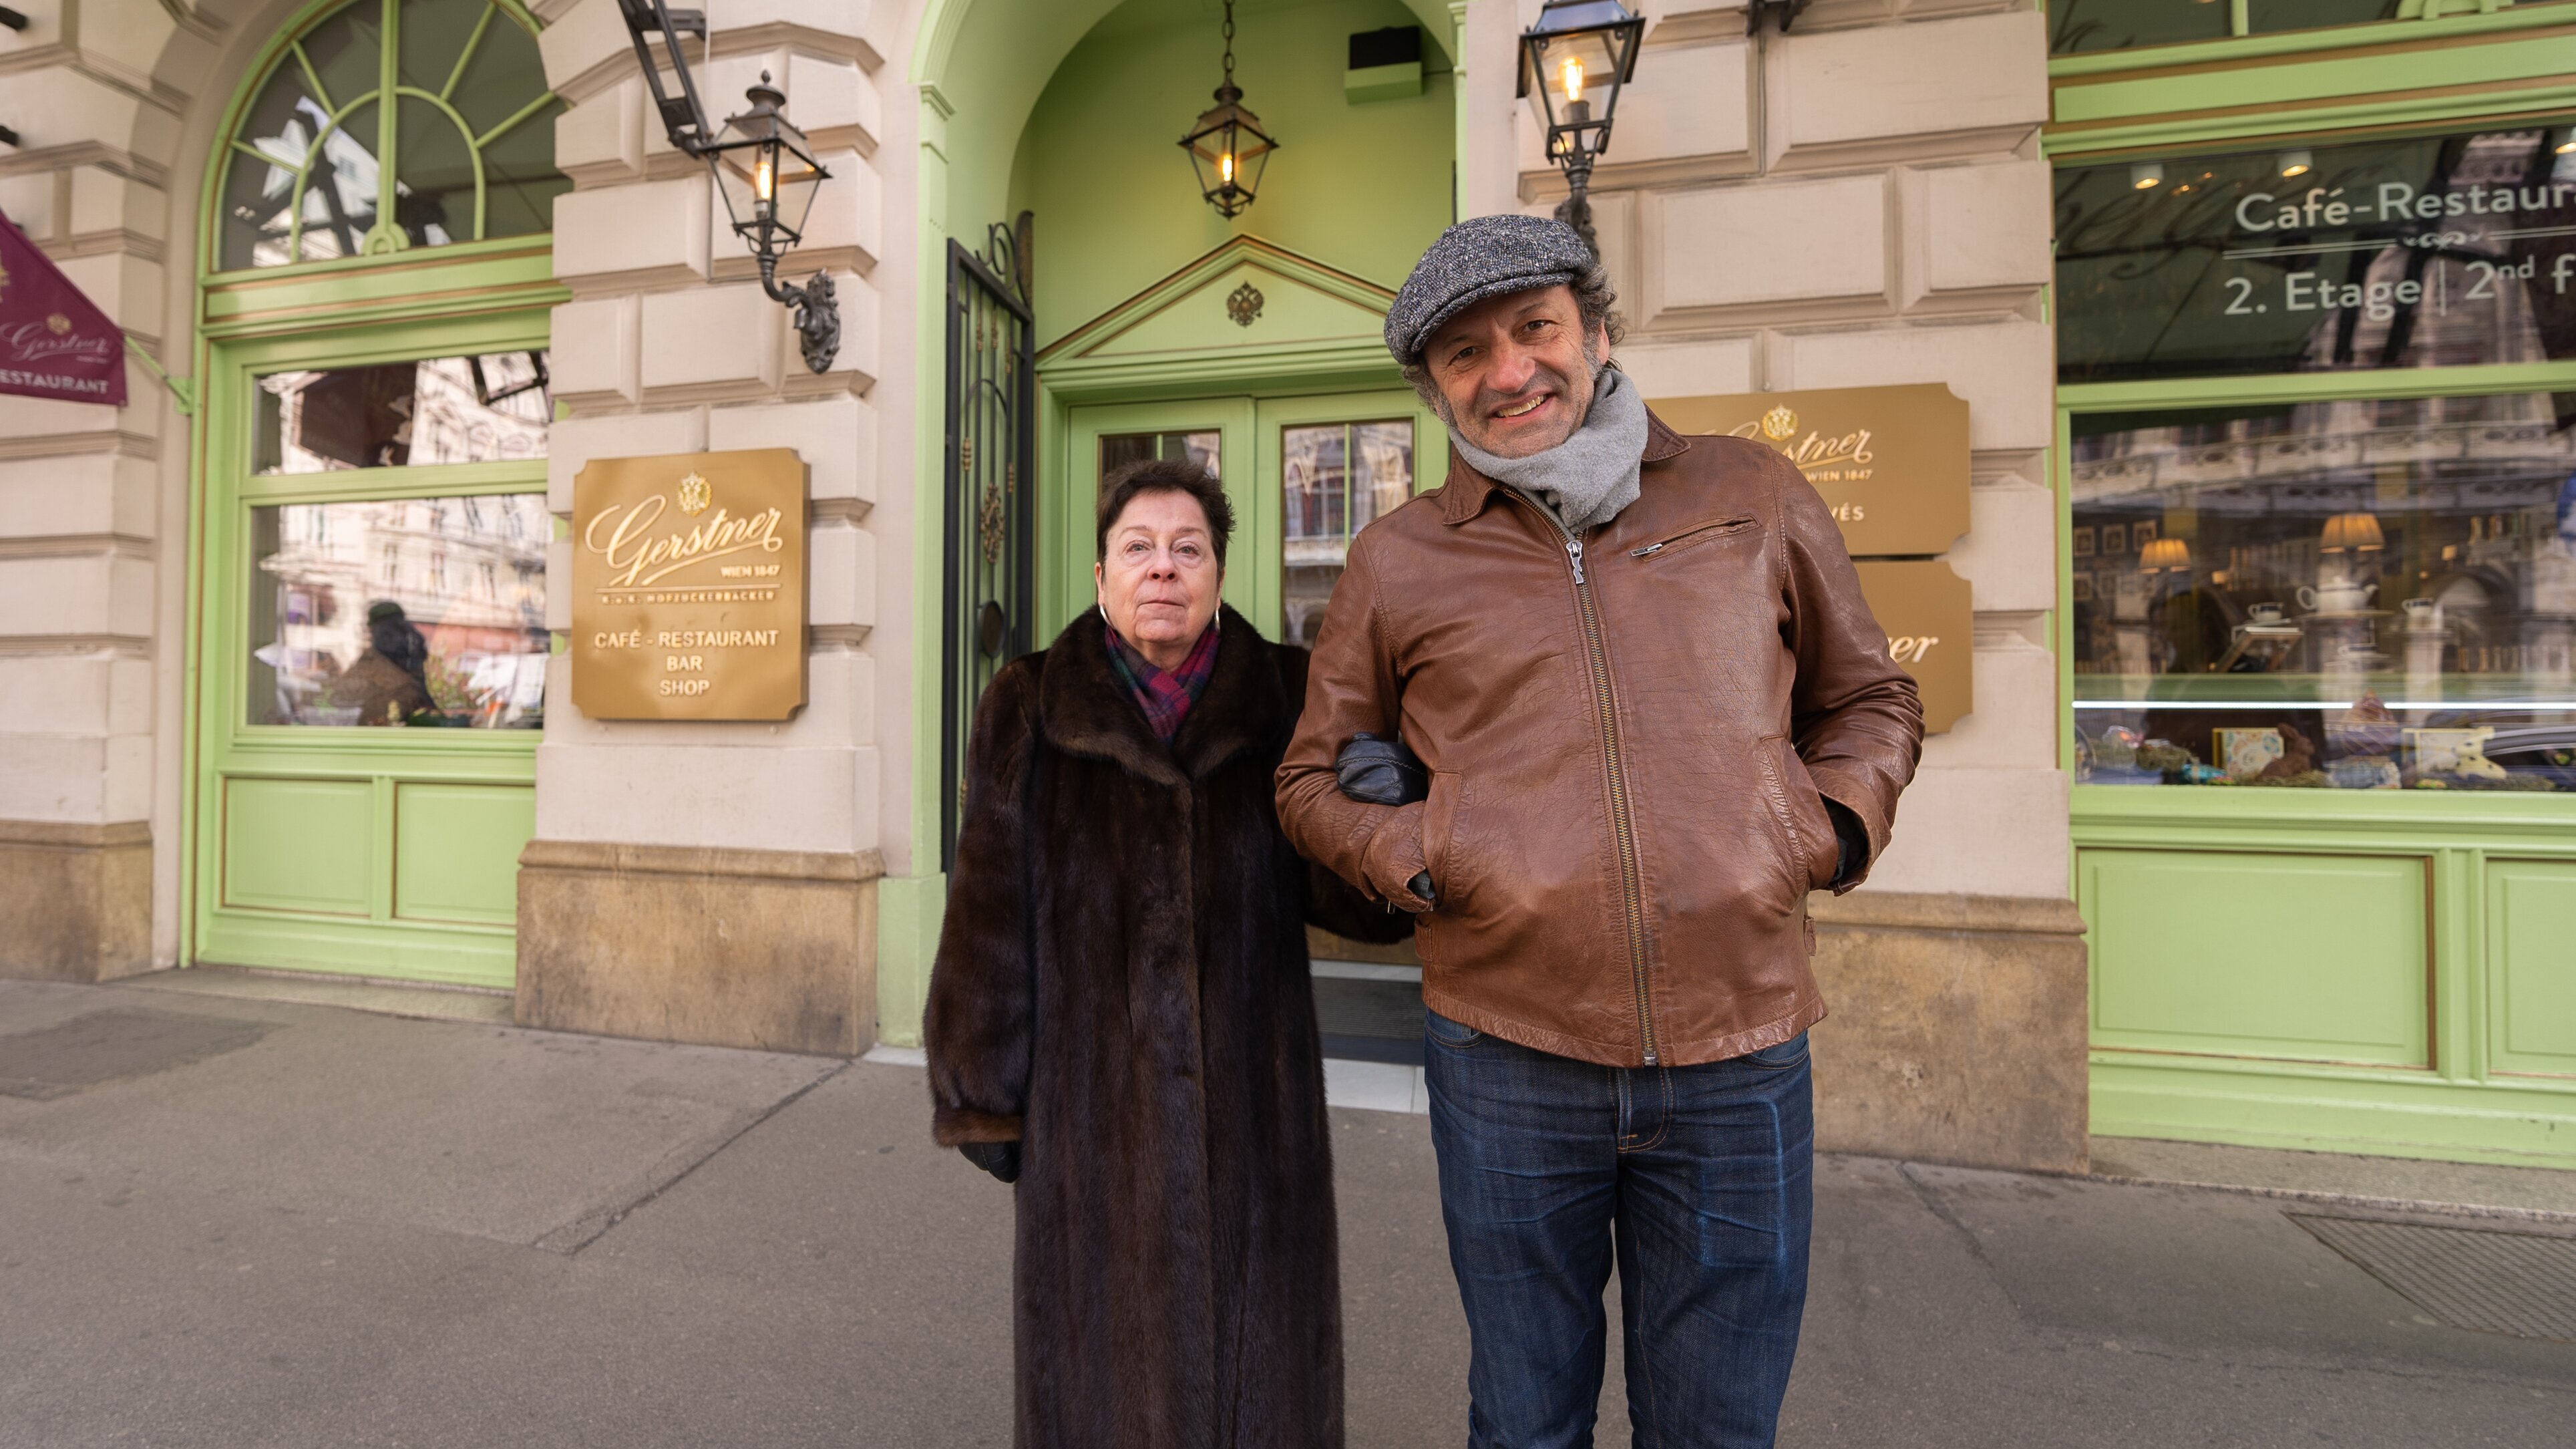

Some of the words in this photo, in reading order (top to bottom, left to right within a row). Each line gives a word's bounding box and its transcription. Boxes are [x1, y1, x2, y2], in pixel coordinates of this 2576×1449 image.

[2235, 181, 2576, 232] Café-Restaur
[2224, 277, 2267, 315] 2.
[2285, 271, 2422, 321] Etage
[0, 368, 108, 395] ESTAURANT
[1806, 470, 1840, 482] WIEN
[1845, 469, 1873, 481] 1847
[585, 494, 783, 587] Gerstner
[720, 565, 753, 578] WIEN
[753, 565, 781, 577] 1847
[594, 629, 642, 649] CAFÉ
[659, 629, 779, 648] RESTAURANT
[667, 655, 703, 672] BAR
[659, 679, 711, 697] SHOP
